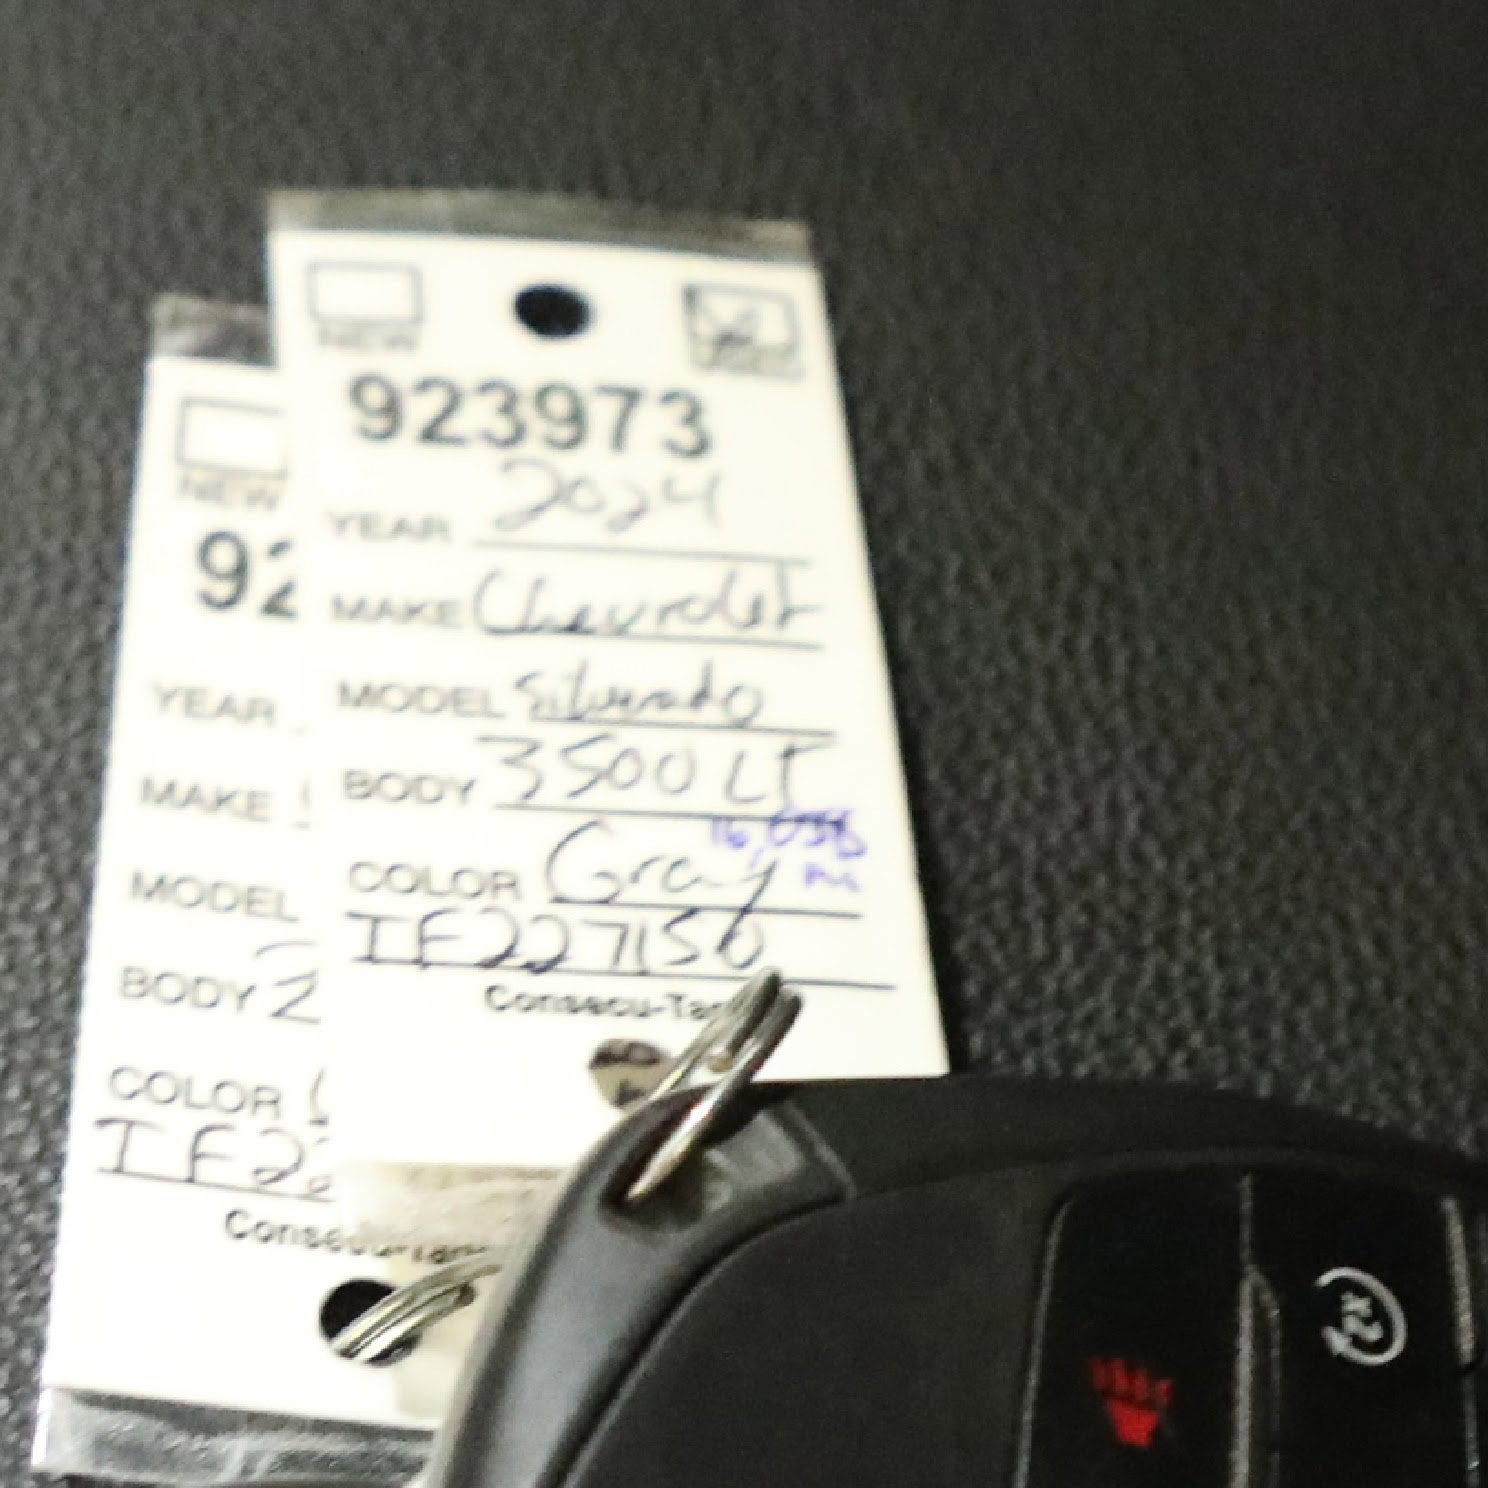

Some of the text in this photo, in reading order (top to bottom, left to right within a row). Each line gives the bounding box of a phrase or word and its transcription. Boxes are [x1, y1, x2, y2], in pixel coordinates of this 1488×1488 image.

[348, 372, 715, 460] 923973
[327, 456, 723, 544] YEAR 2024
[331, 593, 463, 629] MAKE
[151, 681, 278, 728] YEAR
[337, 679, 506, 720] MODEL
[342, 767, 479, 807] BODY
[475, 732, 697, 802] 3500
[140, 775, 272, 824] MAKE
[129, 868, 301, 924] MODEL
[348, 860, 522, 901] COLOR
[120, 963, 258, 1014] BODY
[109, 1065, 282, 1121] COLOR
